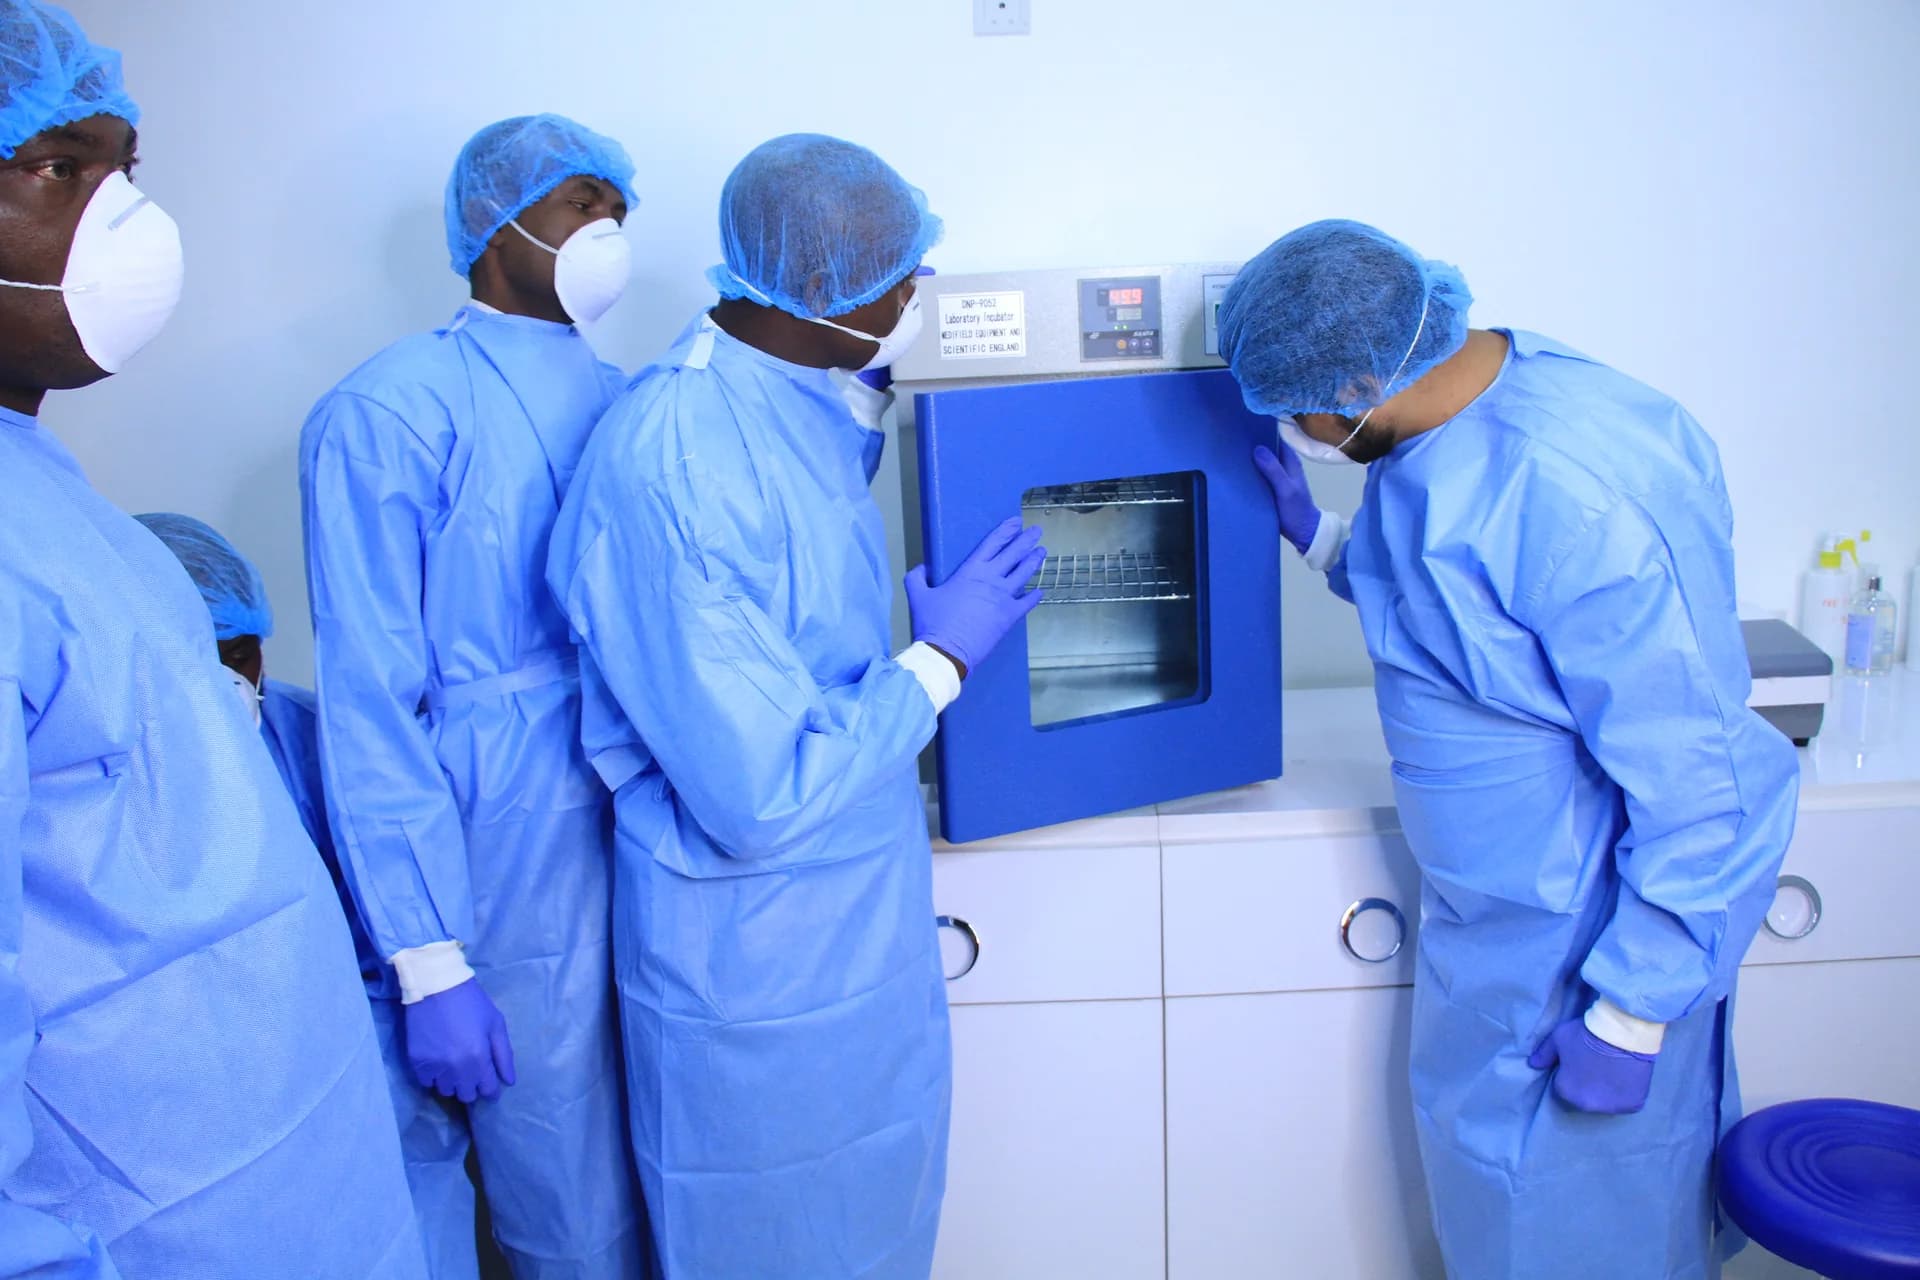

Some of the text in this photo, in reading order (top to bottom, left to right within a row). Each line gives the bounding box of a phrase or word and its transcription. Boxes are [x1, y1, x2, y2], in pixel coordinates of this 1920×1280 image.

[945, 312, 1014, 325] Laboratory Incubator
[941, 328, 1020, 340] MEDIFIELD EQUIPMENT AND
[943, 342, 1019, 354] SCIENTIFIC ENGLAND
